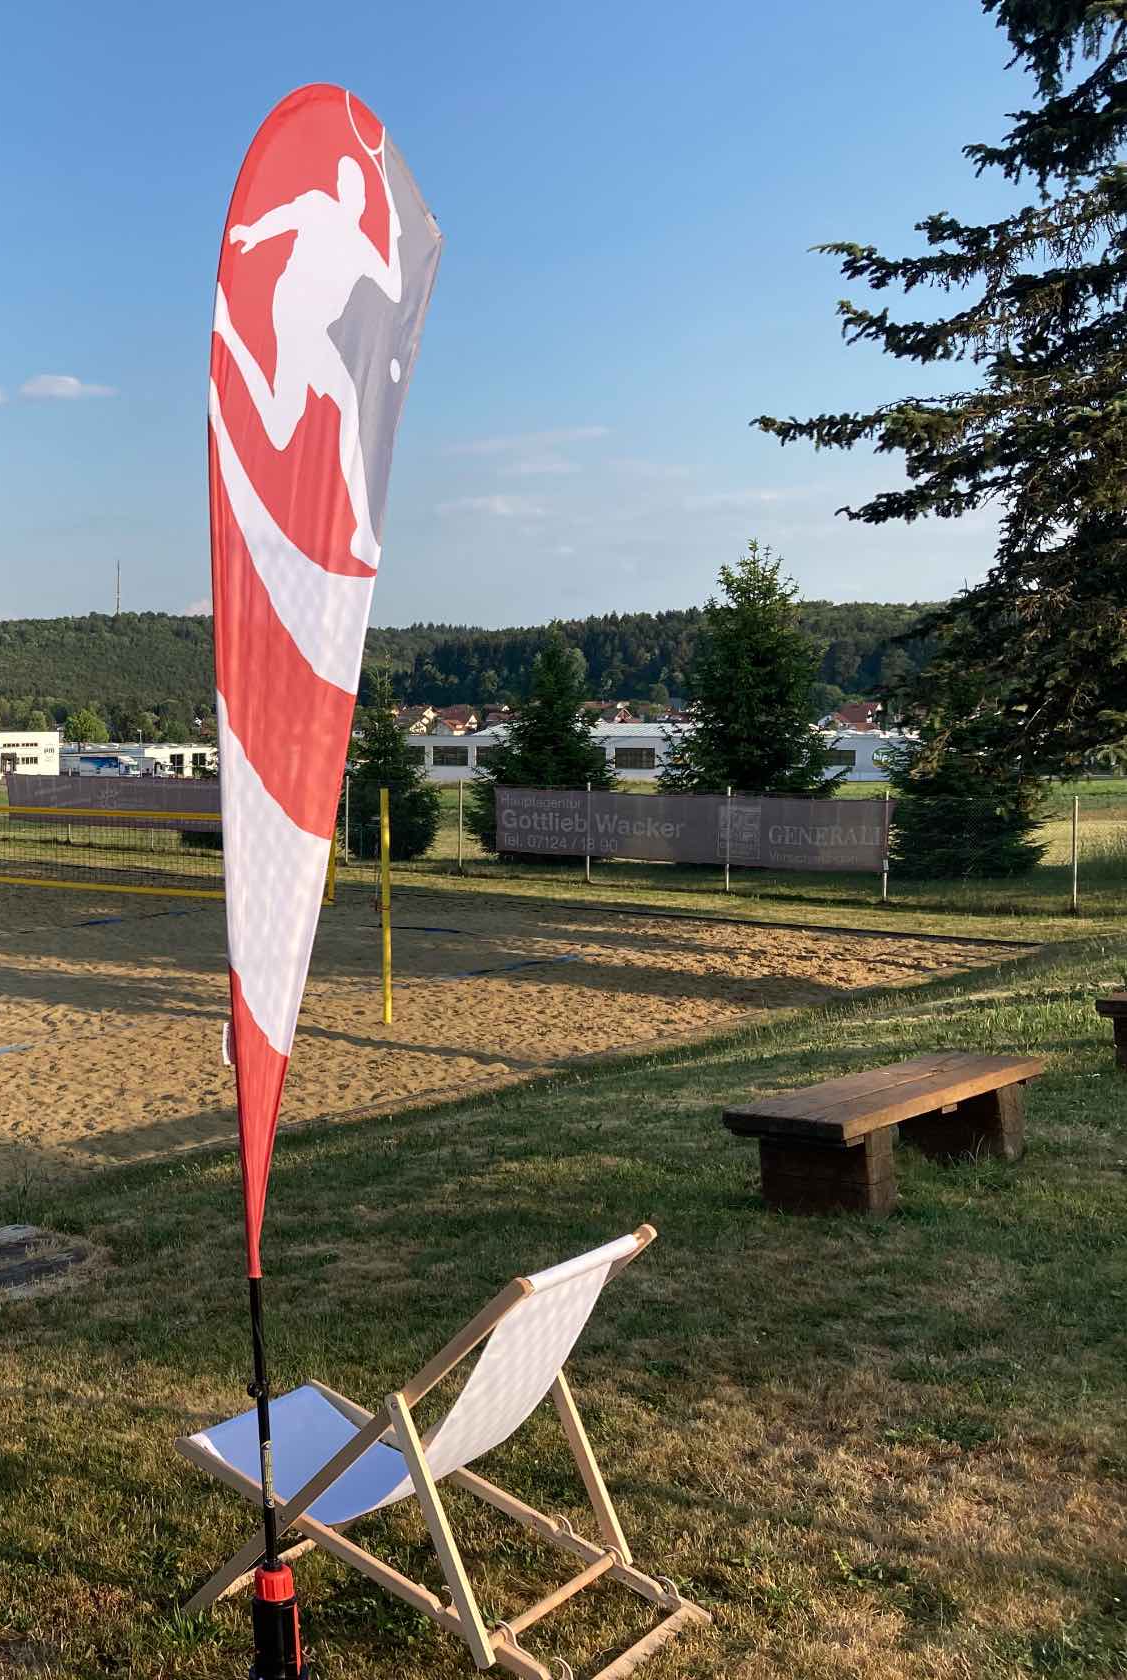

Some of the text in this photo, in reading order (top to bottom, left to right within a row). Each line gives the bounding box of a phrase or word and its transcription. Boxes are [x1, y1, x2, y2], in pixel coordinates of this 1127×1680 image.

[502, 809, 686, 838] Gottlieb Wacker
[504, 832, 523, 849] Tel.
[527, 834, 567, 850] 07124
[769, 824, 881, 846] GENERALI
